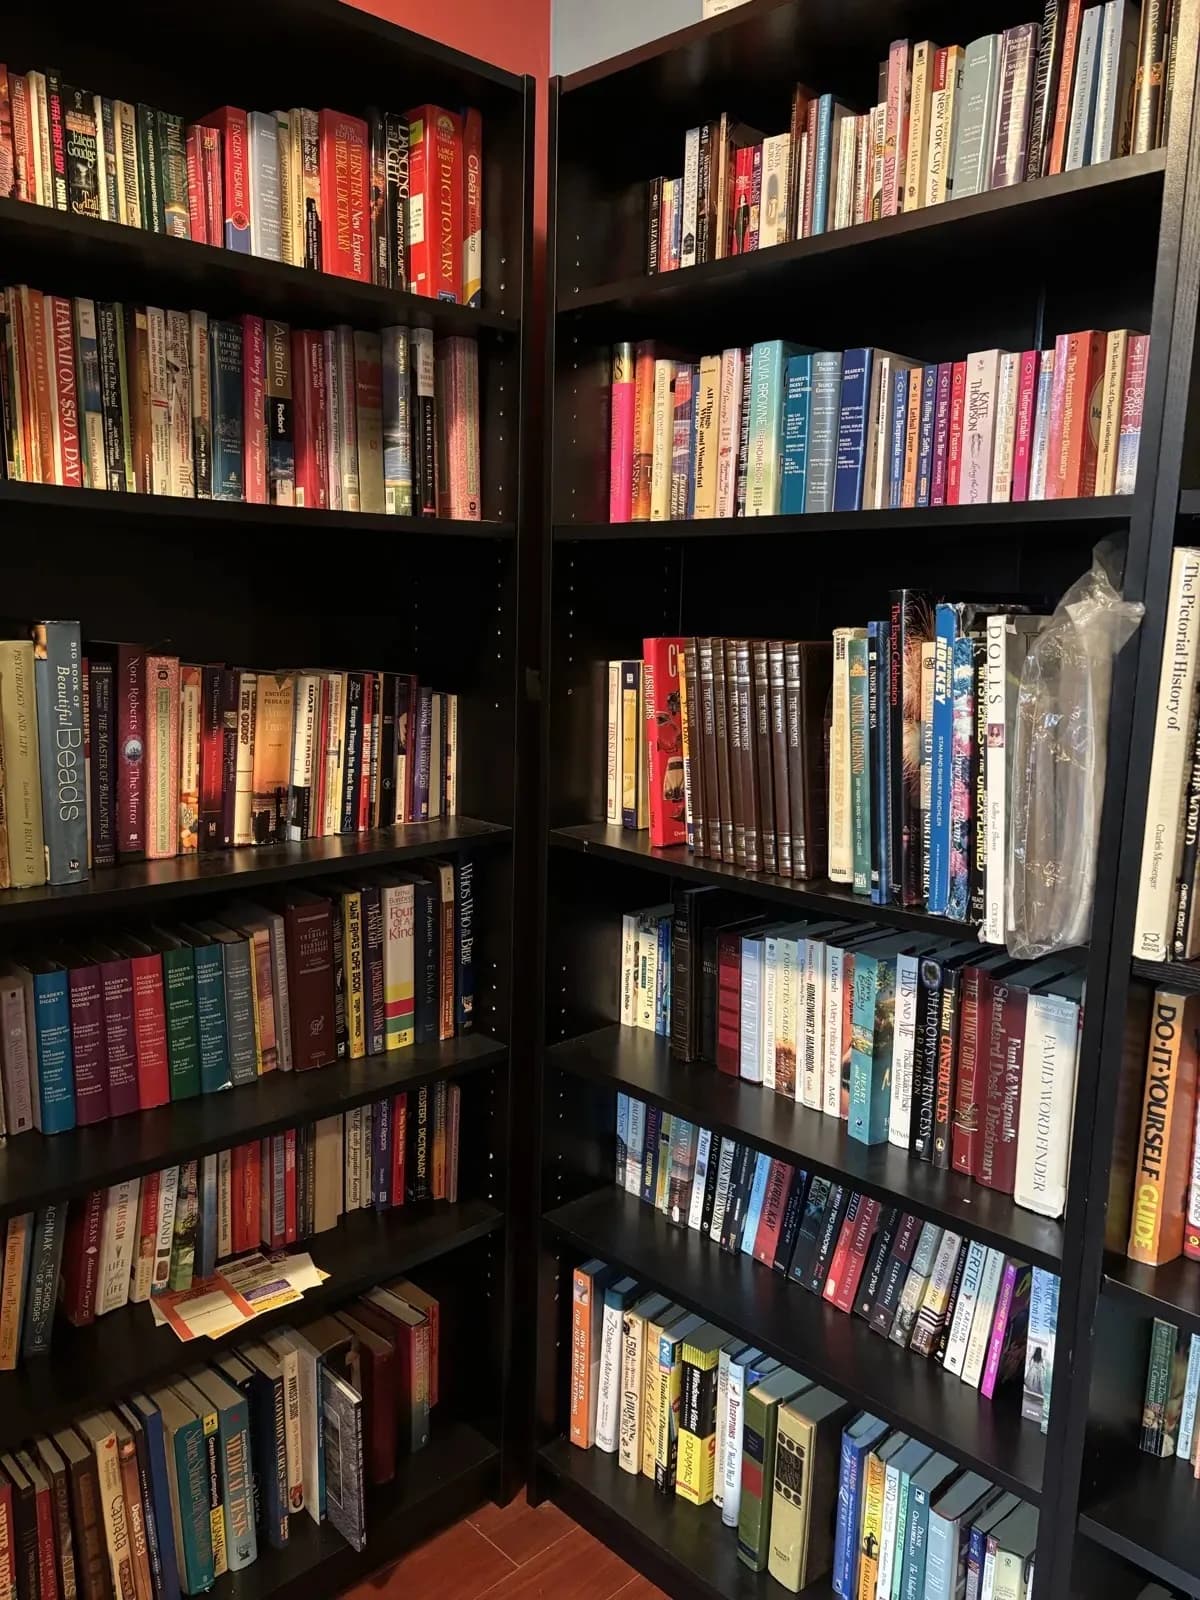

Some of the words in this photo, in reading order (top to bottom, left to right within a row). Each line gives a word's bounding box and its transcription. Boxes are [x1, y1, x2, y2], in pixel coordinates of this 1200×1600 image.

[936, 92, 945, 120] New
[232, 124, 243, 159] ENGLISH
[934, 123, 943, 149] York
[54, 150, 64, 174] LADY
[388, 138, 399, 187] LIGHT
[398, 124, 409, 199] DANCING
[931, 152, 942, 175] City
[56, 177, 66, 202] JOHN
[234, 161, 243, 208] THESAURUS
[467, 154, 480, 205] Clean
[931, 179, 939, 203] 2006
[336, 188, 349, 253] DICTIONARY
[352, 210, 364, 230] New
[441, 164, 453, 282] DICTIONARY
[469, 208, 478, 253] anything
[352, 233, 364, 275] Explorer
[397, 238, 406, 276] MACLAINE
[649, 217, 658, 267] ELIZABETH
[55, 301, 73, 366] HAWAII
[273, 325, 287, 386] Australia
[758, 347, 770, 381] SYLVIA
[1066, 357, 1077, 372] The
[59, 368, 74, 395] ON
[706, 387, 714, 399] All
[60, 399, 76, 428] $50
[699, 408, 708, 428] Wise
[705, 400, 713, 430] Things
[757, 383, 769, 426] BROWNE
[967, 379, 983, 432] THOMPSON
[977, 392, 990, 419] KATE
[1123, 388, 1134, 417] CARR
[63, 430, 77, 442] A
[424, 405, 433, 450] GARRICK
[64, 447, 80, 482] DAY
[425, 456, 433, 488] UTLEY
[696, 447, 705, 488] Wonderful
[1058, 440, 1072, 479] Dictionary
[678, 473, 688, 514] CHARLOTTE
[1182, 562, 1199, 593] The
[891, 603, 900, 623] The
[1174, 594, 1194, 657] Pictorial
[889, 624, 900, 649] Expo
[12, 650, 26, 709] PSYCHOLOGY
[71, 664, 79, 690] BOOK
[128, 657, 140, 684] Nora
[644, 665, 655, 697] CLASSIC
[869, 665, 877, 694] UNDER
[891, 651, 900, 706] Celebration
[936, 637, 948, 705] HOCKEY
[988, 625, 1002, 705] DOLLS
[54, 666, 72, 726] Beautiful
[241, 691, 251, 710] THE
[307, 684, 315, 713] WAR
[1167, 660, 1188, 709] History
[72, 695, 80, 708] OF
[128, 688, 140, 730] Roberts
[645, 699, 656, 719] CARS
[851, 694, 864, 727] NATURAL
[17, 712, 27, 732] AND
[98, 713, 108, 732] THE
[241, 712, 250, 745] GODS?
[306, 716, 314, 731] ON
[1167, 710, 1180, 732] of
[18, 736, 29, 757] LIFE
[98, 732, 109, 770] MASTER
[304, 733, 313, 774] TERROR
[851, 729, 865, 775] GARDENING
[56, 728, 84, 821] Beads
[99, 771, 108, 784] OF
[129, 769, 139, 790] The
[953, 747, 966, 790] America
[98, 785, 110, 840] BALLANTRAE
[130, 793, 139, 825] Mirror
[952, 809, 966, 842] Bloom
[922, 811, 931, 841] NORTH
[1153, 824, 1166, 852] Charles
[460, 862, 474, 899] WHO'S
[922, 844, 931, 898] AMERICA
[1149, 852, 1163, 889] Messenger
[350, 901, 359, 920] AUNT
[460, 900, 474, 927] WHO
[352, 972, 360, 994] BOOK
[646, 977, 655, 1009] BINCHY
[901, 969, 915, 998] ELVIS
[967, 979, 978, 998] THE
[806, 983, 816, 1034] HOMEOWNER'S
[903, 1001, 912, 1019] AND
[924, 990, 939, 1056] SHADOWS
[941, 987, 954, 1030] Trudeau
[965, 1002, 976, 1015] DA
[990, 985, 1009, 1058] Standard
[782, 1007, 790, 1044] GARDEN
[899, 1022, 914, 1039] ME
[962, 1017, 976, 1044] VINCI
[805, 1035, 814, 1073] HANDBOOK
[962, 1046, 974, 1070] CODE
[1006, 1037, 1021, 1072] Funk
[1041, 1034, 1057, 1091] FAMILY
[852, 1080, 861, 1105] SOUL
[859, 1072, 867, 1104] HEART
[937, 1035, 952, 1123] CONSEQUENCES
[960, 1079, 973, 1098] DAN
[988, 1061, 1002, 1099] Desk
[919, 1076, 934, 1137] PRINCESS
[1002, 1082, 1019, 1142] Wagnalls
[1036, 1091, 1051, 1137] WORD
[417, 1128, 427, 1179] DICTIONARY
[980, 1104, 999, 1184] Dictionary
[164, 1169, 177, 1193] NEW
[1033, 1138, 1048, 1192] FINDER
[115, 1194, 127, 1240] ATKINSON
[160, 1196, 174, 1246] ZEALAND
[853, 1215, 872, 1249] FAMILY
[1133, 1184, 1159, 1251] GUIDE
[898, 1231, 911, 1251] WIFE
[36, 1274, 44, 1285] OF
[46, 1264, 54, 1280] THE
[889, 1262, 901, 1283] ELLEN
[32, 1288, 43, 1322] MIRRORS
[42, 1282, 53, 1313] SCHOOL
[883, 1284, 894, 1306] KEITH
[1031, 1285, 1041, 1316] Saffron
[604, 1326, 615, 1353] Stages
[959, 1310, 971, 1344] KAITLYN
[1031, 1318, 1041, 1334] Hall
[571, 1377, 579, 1415] ANYTHING
[602, 1361, 613, 1399] Marriage
[690, 1369, 700, 1402] Windows
[690, 1405, 699, 1432] Vista
[727, 1399, 739, 1439] DECEPTIONS
[208, 1437, 216, 1455] Green
[727, 1451, 736, 1467] World
[209, 1457, 217, 1473] Home
[726, 1469, 735, 1479] War
[210, 1474, 219, 1507] Computing
[111, 1494, 128, 1552] Canada
[131, 1503, 141, 1533] Decks
[909, 1510, 921, 1556] CHAMBERLAIN
[135, 1533, 144, 1556] 1-2-3
